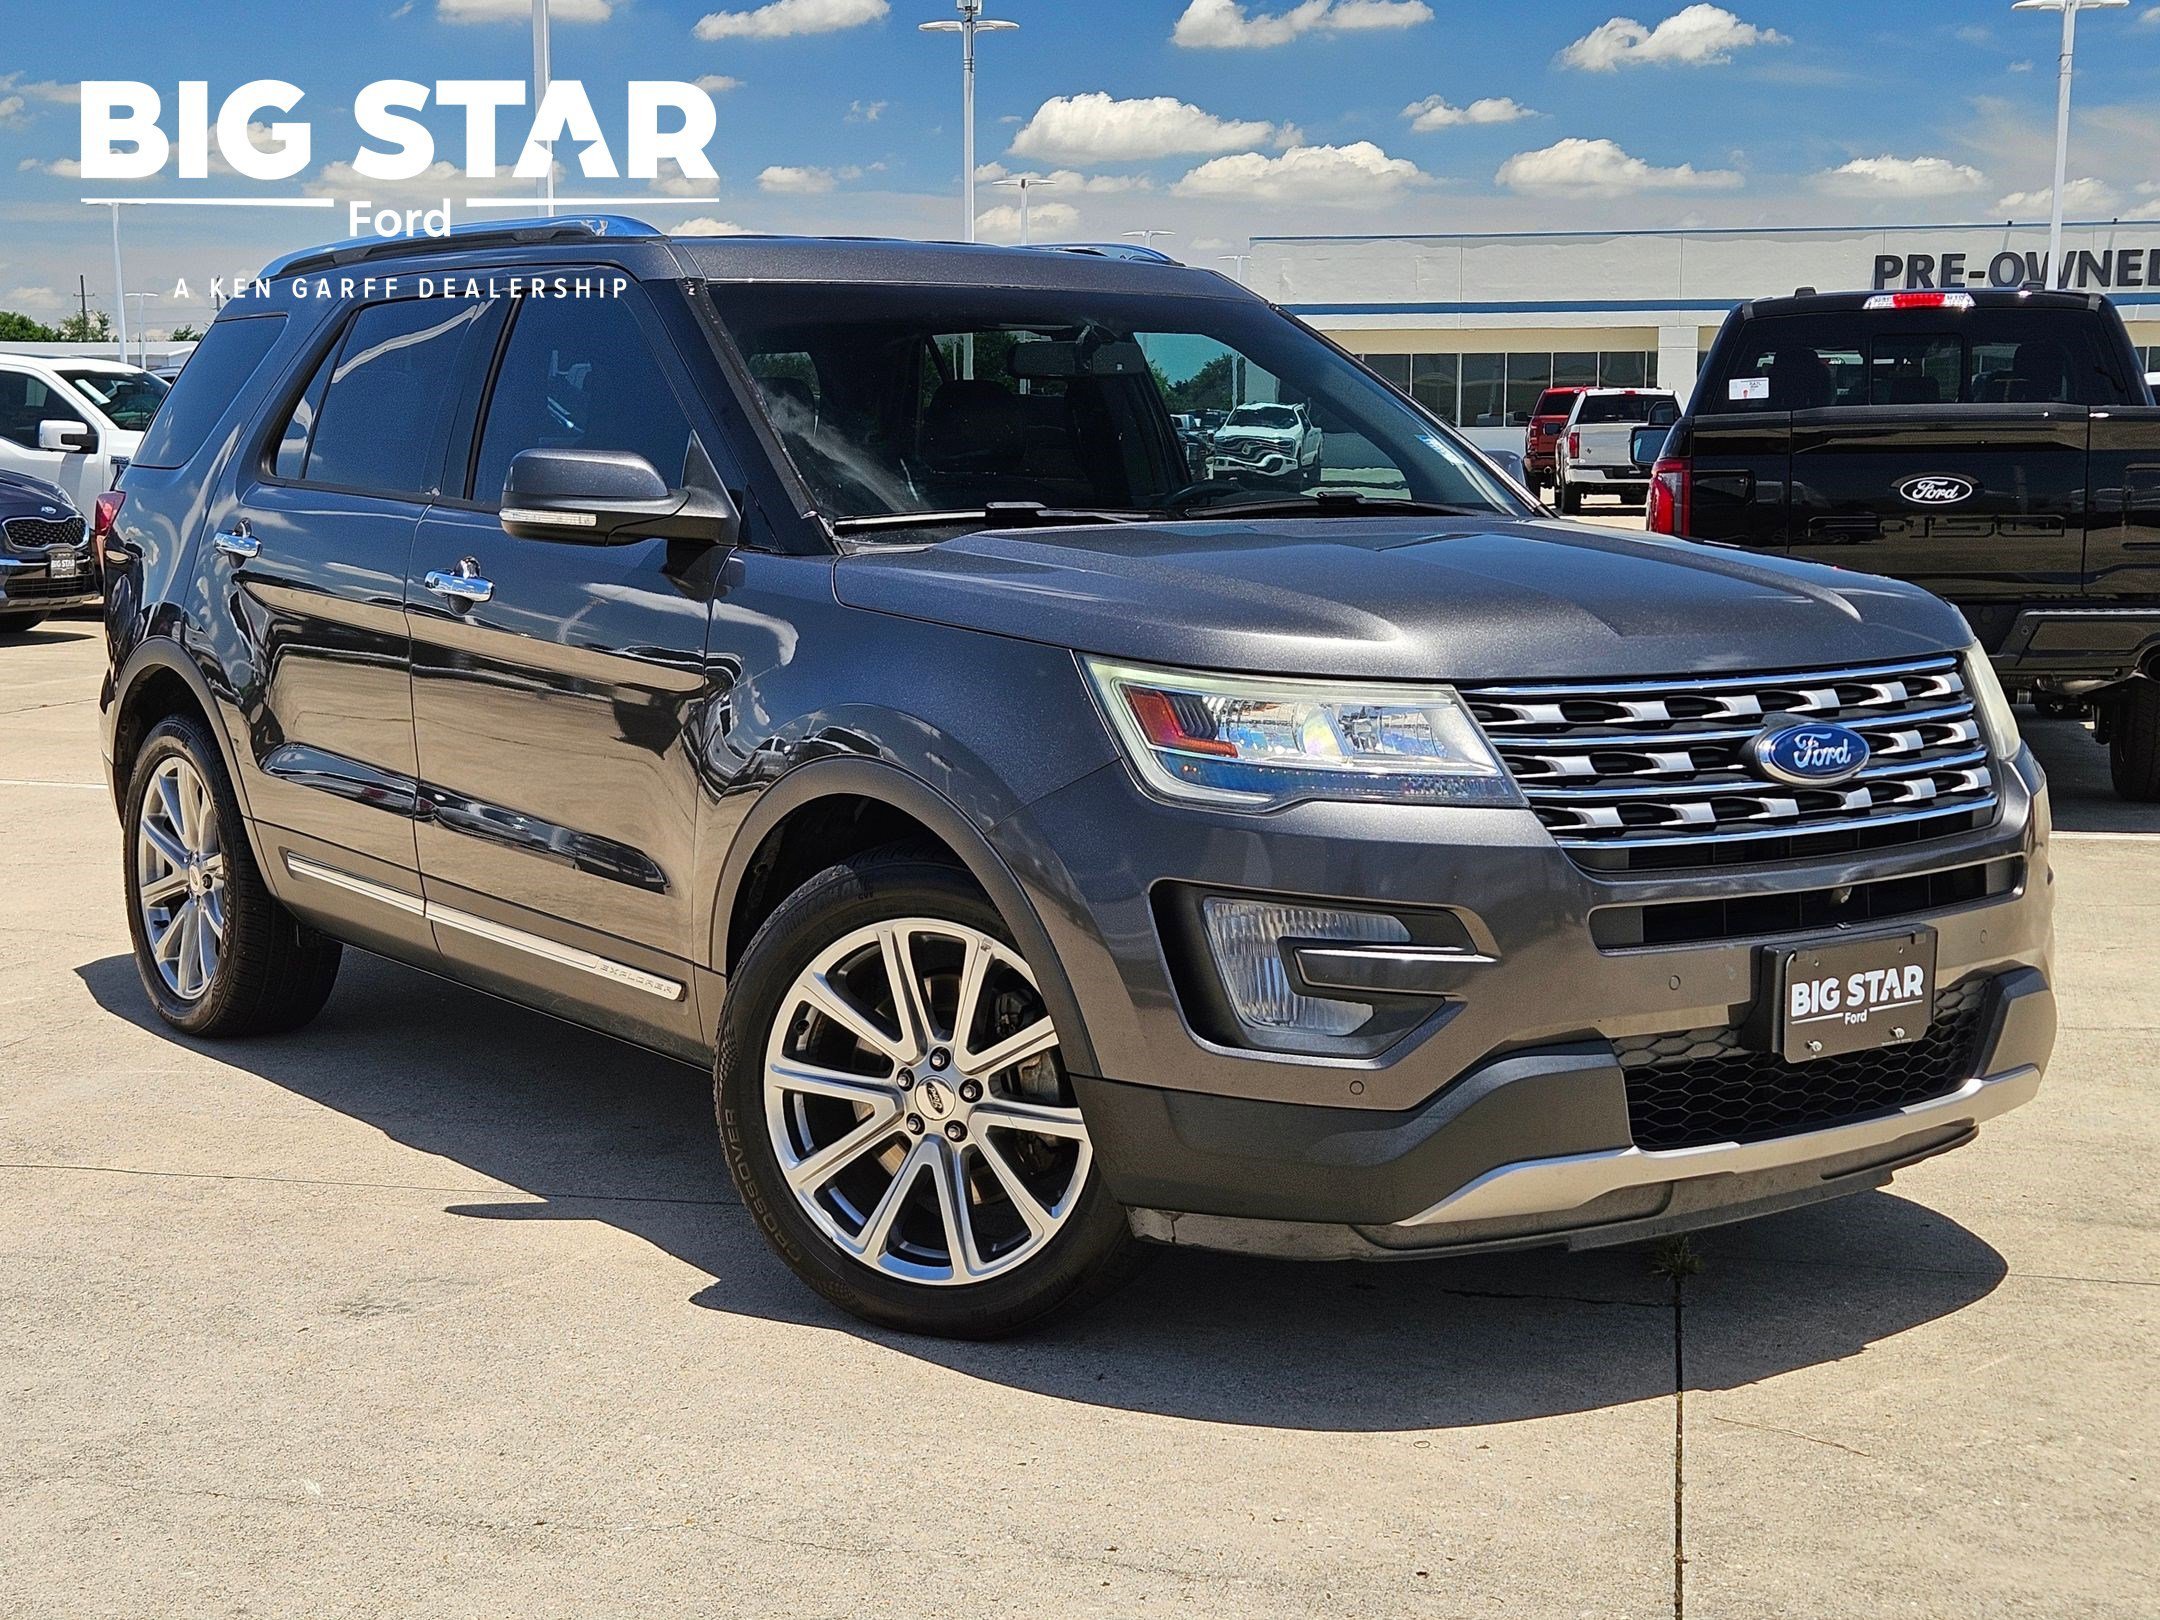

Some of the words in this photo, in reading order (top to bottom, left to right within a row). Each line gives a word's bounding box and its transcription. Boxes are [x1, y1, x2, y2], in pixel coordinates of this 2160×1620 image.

[1912, 479, 1959, 500] Ford
[1793, 732, 1852, 769] Ford
[599, 963, 673, 994] EXPLORER
[1791, 977, 1841, 1018] BIG
[1846, 965, 1924, 1006] STAR
[1844, 1009, 1868, 1026] Ford
[725, 1108, 802, 1262] CROSSOVER
